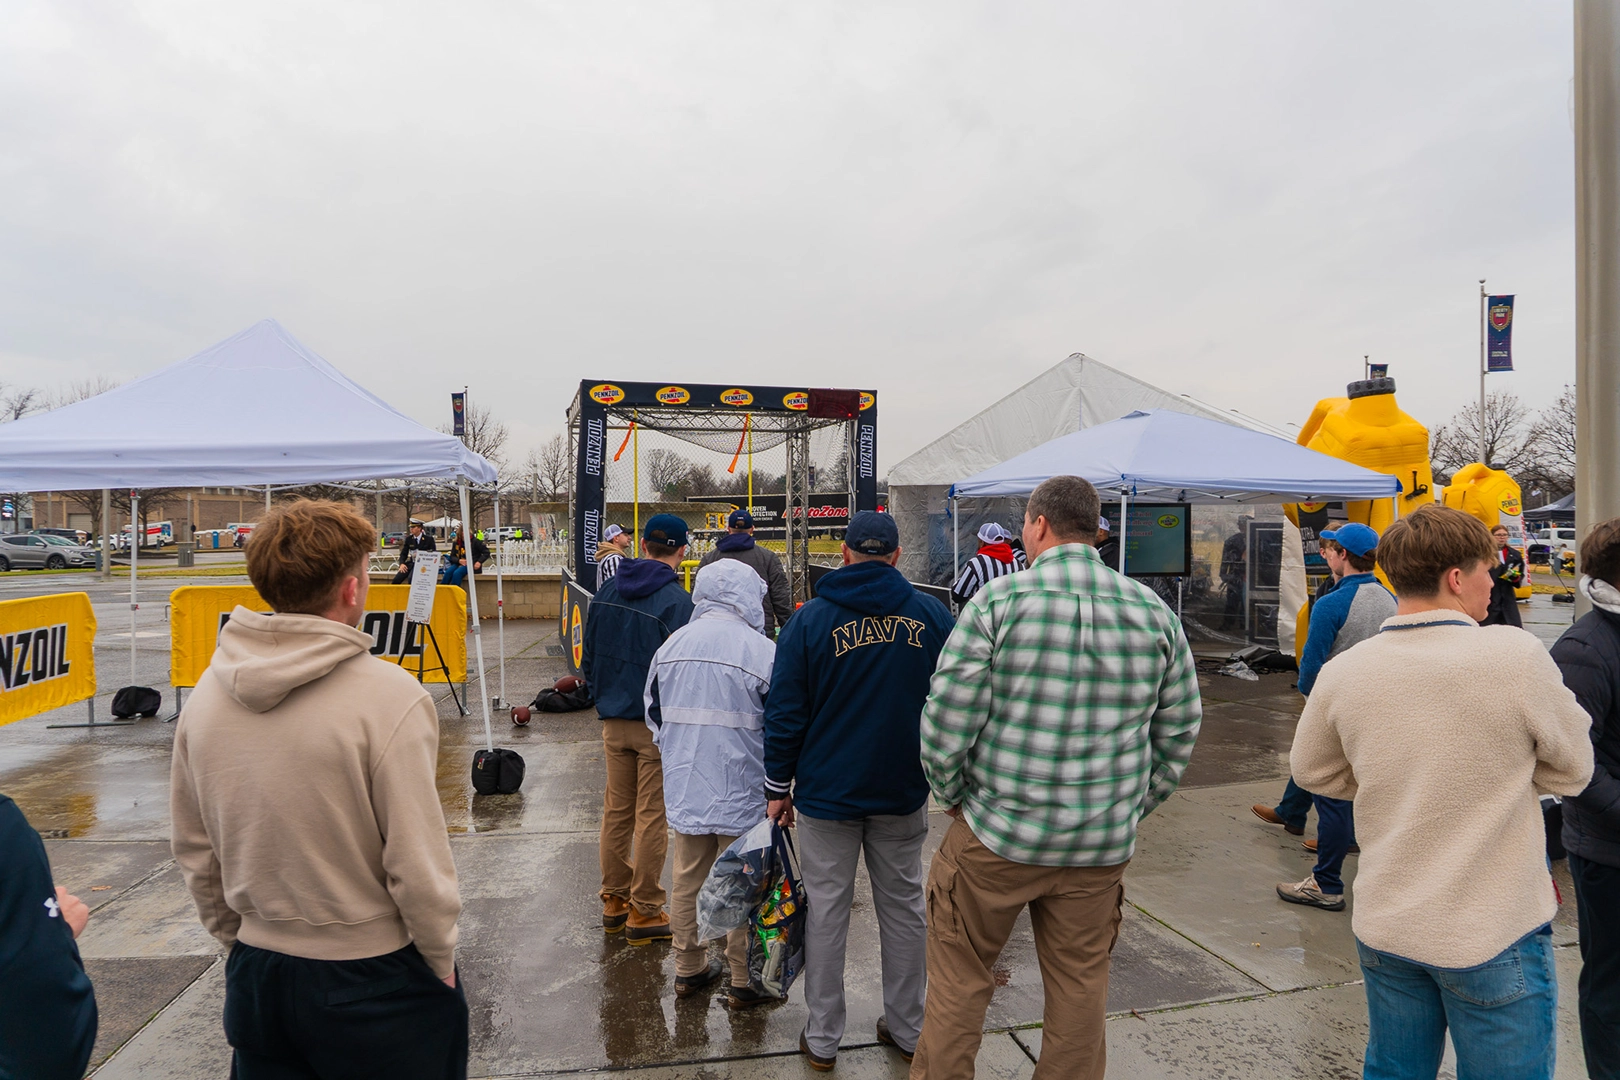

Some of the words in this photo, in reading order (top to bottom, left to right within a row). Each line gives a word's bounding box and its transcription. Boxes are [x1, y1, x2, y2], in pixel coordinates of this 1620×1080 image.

[593, 390, 620, 398] PENNZOIL
[724, 394, 749, 402] PENNZOIL
[787, 397, 808, 405] PENNZO
[586, 418, 602, 475] PENNZOIL
[860, 424, 874, 478] PENNZOIL
[832, 615, 925, 657] NAVY
[0, 623, 71, 692] NZOIL
